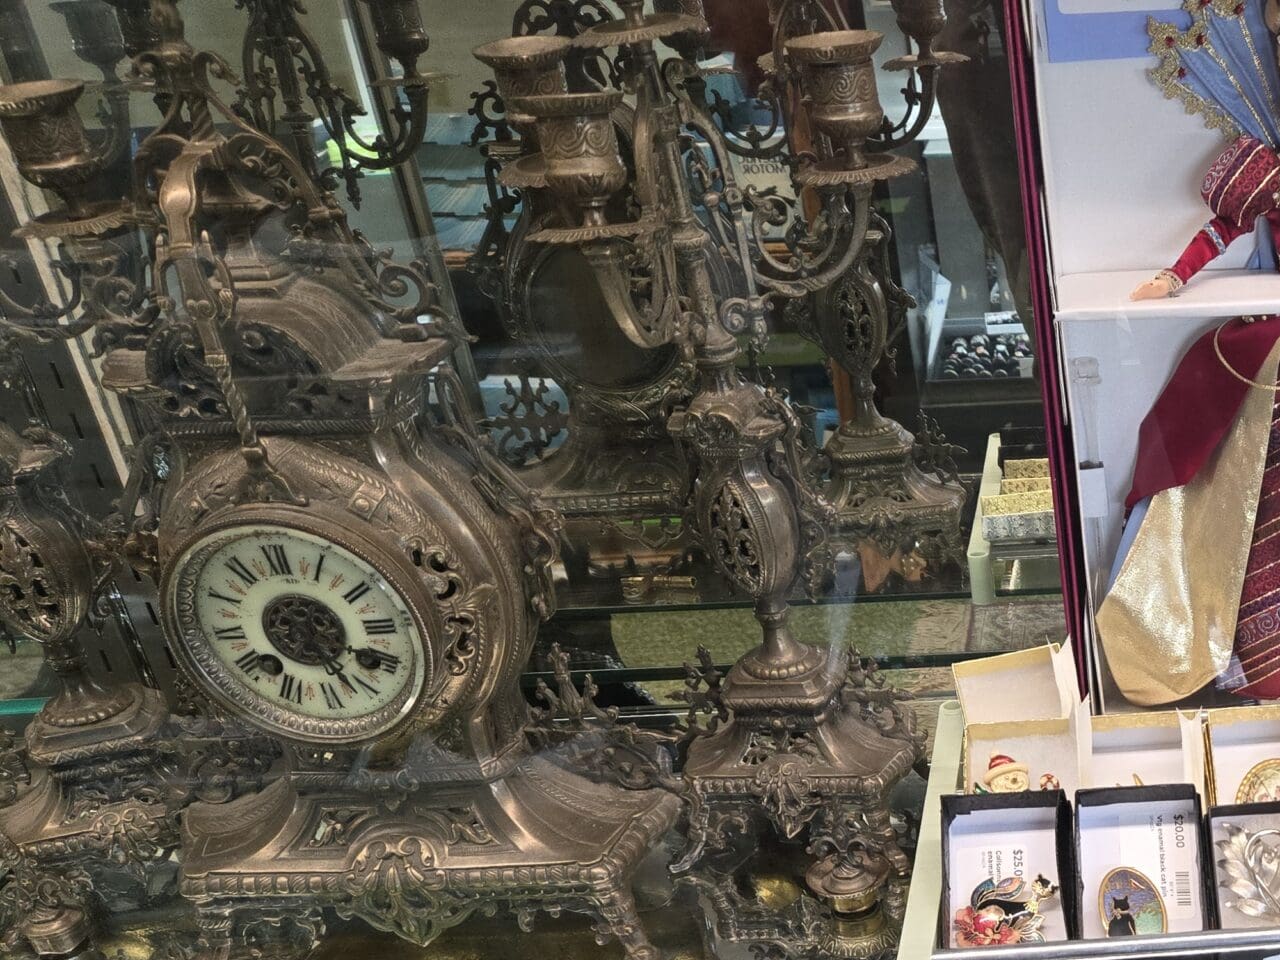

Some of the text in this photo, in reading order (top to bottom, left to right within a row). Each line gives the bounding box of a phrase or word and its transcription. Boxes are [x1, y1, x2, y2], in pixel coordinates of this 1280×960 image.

[1155, 814, 1163, 827] Vtg
[1173, 813, 1186, 848] $20.00
[1012, 849, 1024, 877] $25.0
